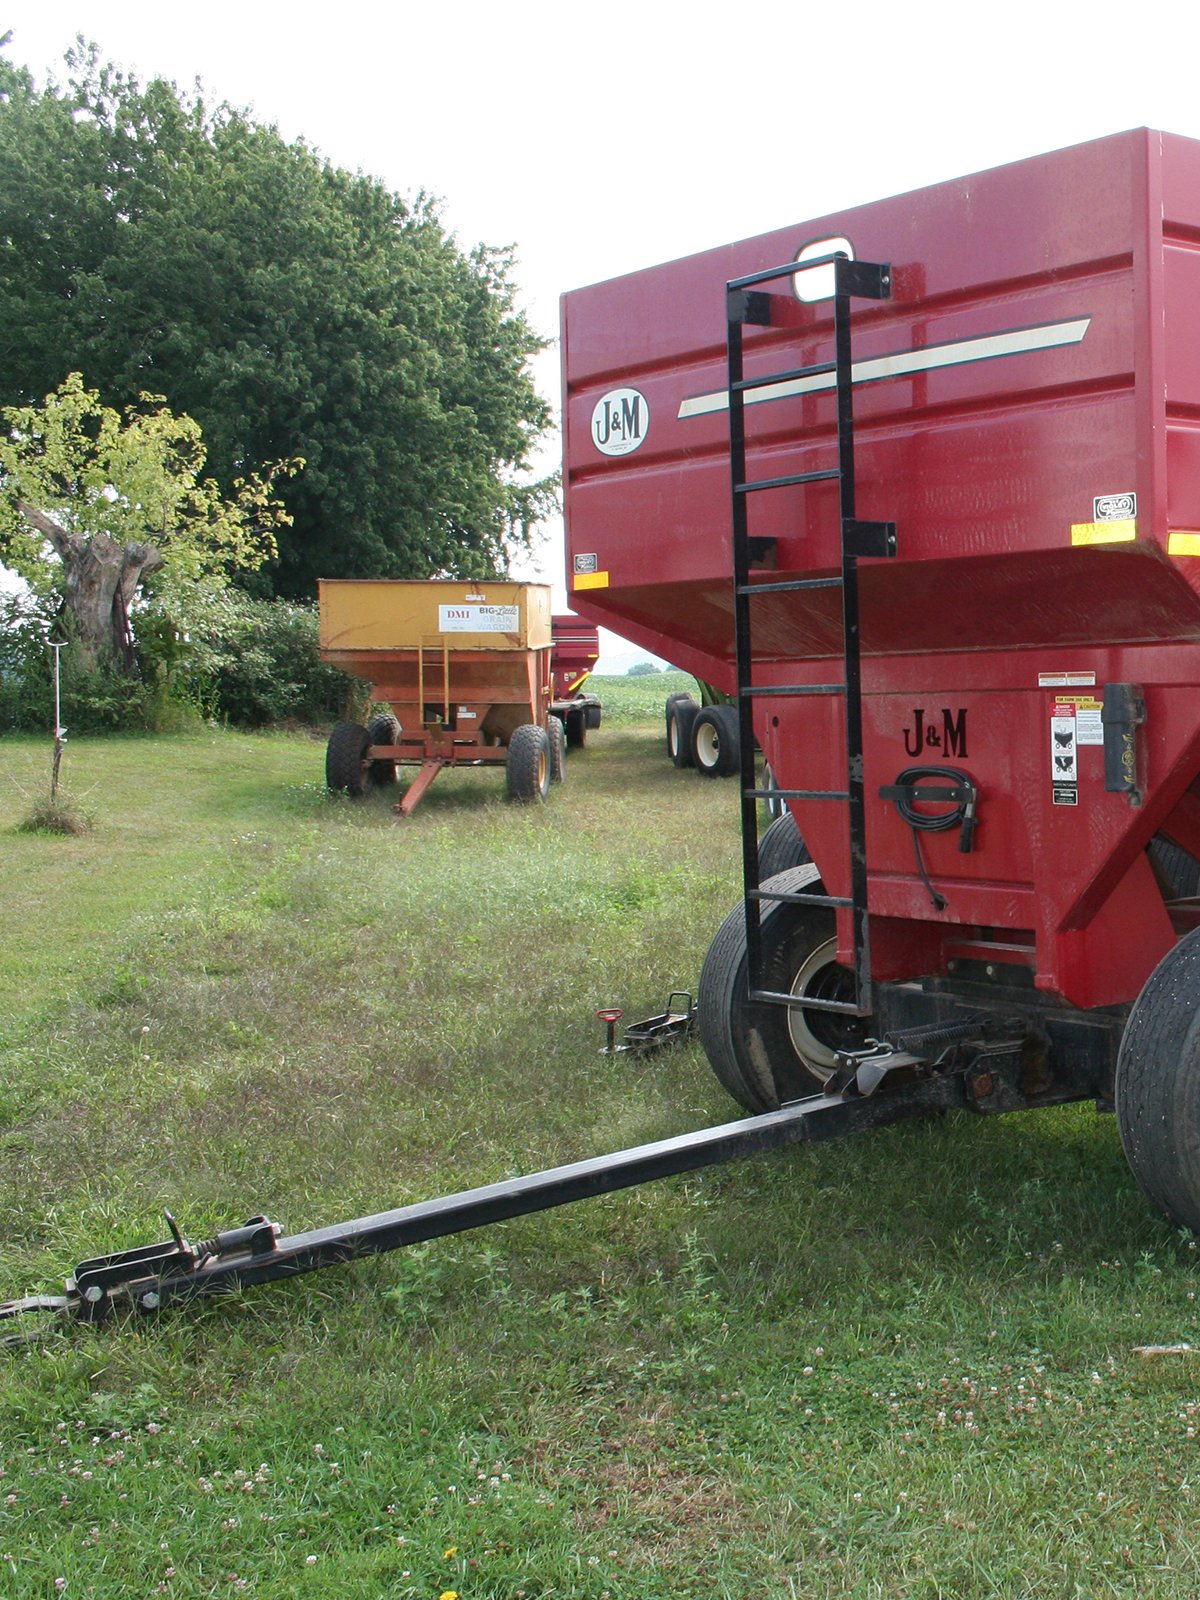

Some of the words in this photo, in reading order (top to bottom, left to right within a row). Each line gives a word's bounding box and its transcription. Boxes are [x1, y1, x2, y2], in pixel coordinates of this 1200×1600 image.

[596, 395, 641, 445] J&M
[447, 610, 470, 619] DMI
[478, 623, 512, 631] WAGON
[902, 708, 969, 758] J&M
